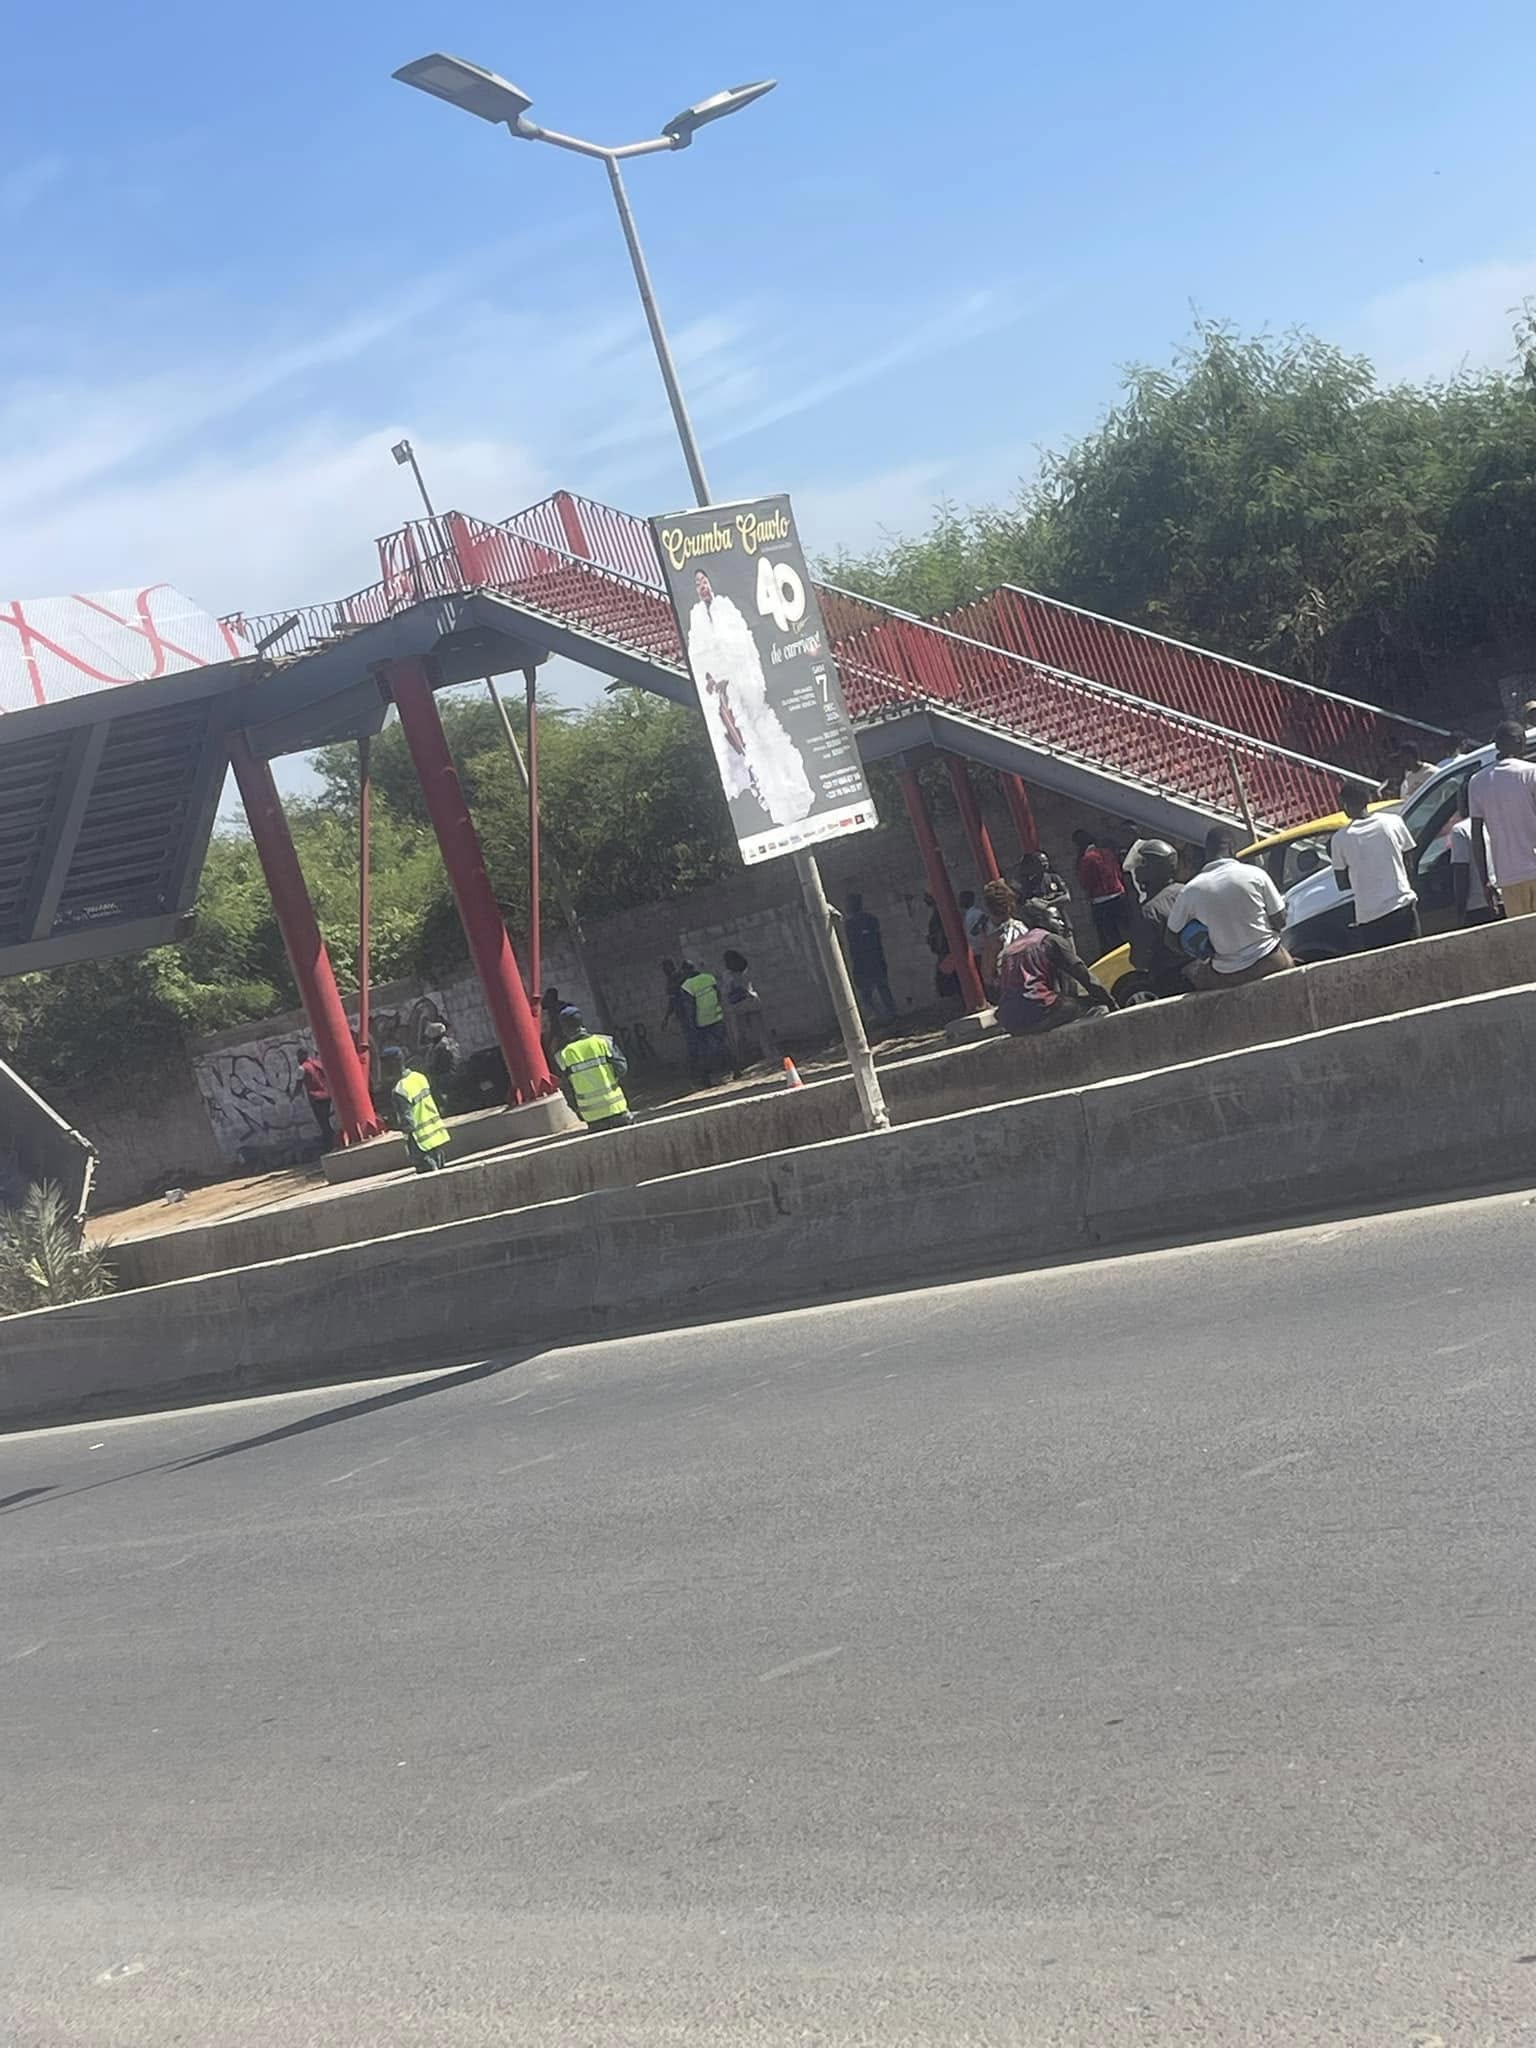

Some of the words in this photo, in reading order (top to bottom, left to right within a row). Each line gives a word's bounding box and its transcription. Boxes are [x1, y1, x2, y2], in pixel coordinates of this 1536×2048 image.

[662, 522, 733, 570] Coumba
[736, 509, 791, 555] Gawlo
[756, 556, 805, 631] 40
[815, 673, 828, 702] 7
